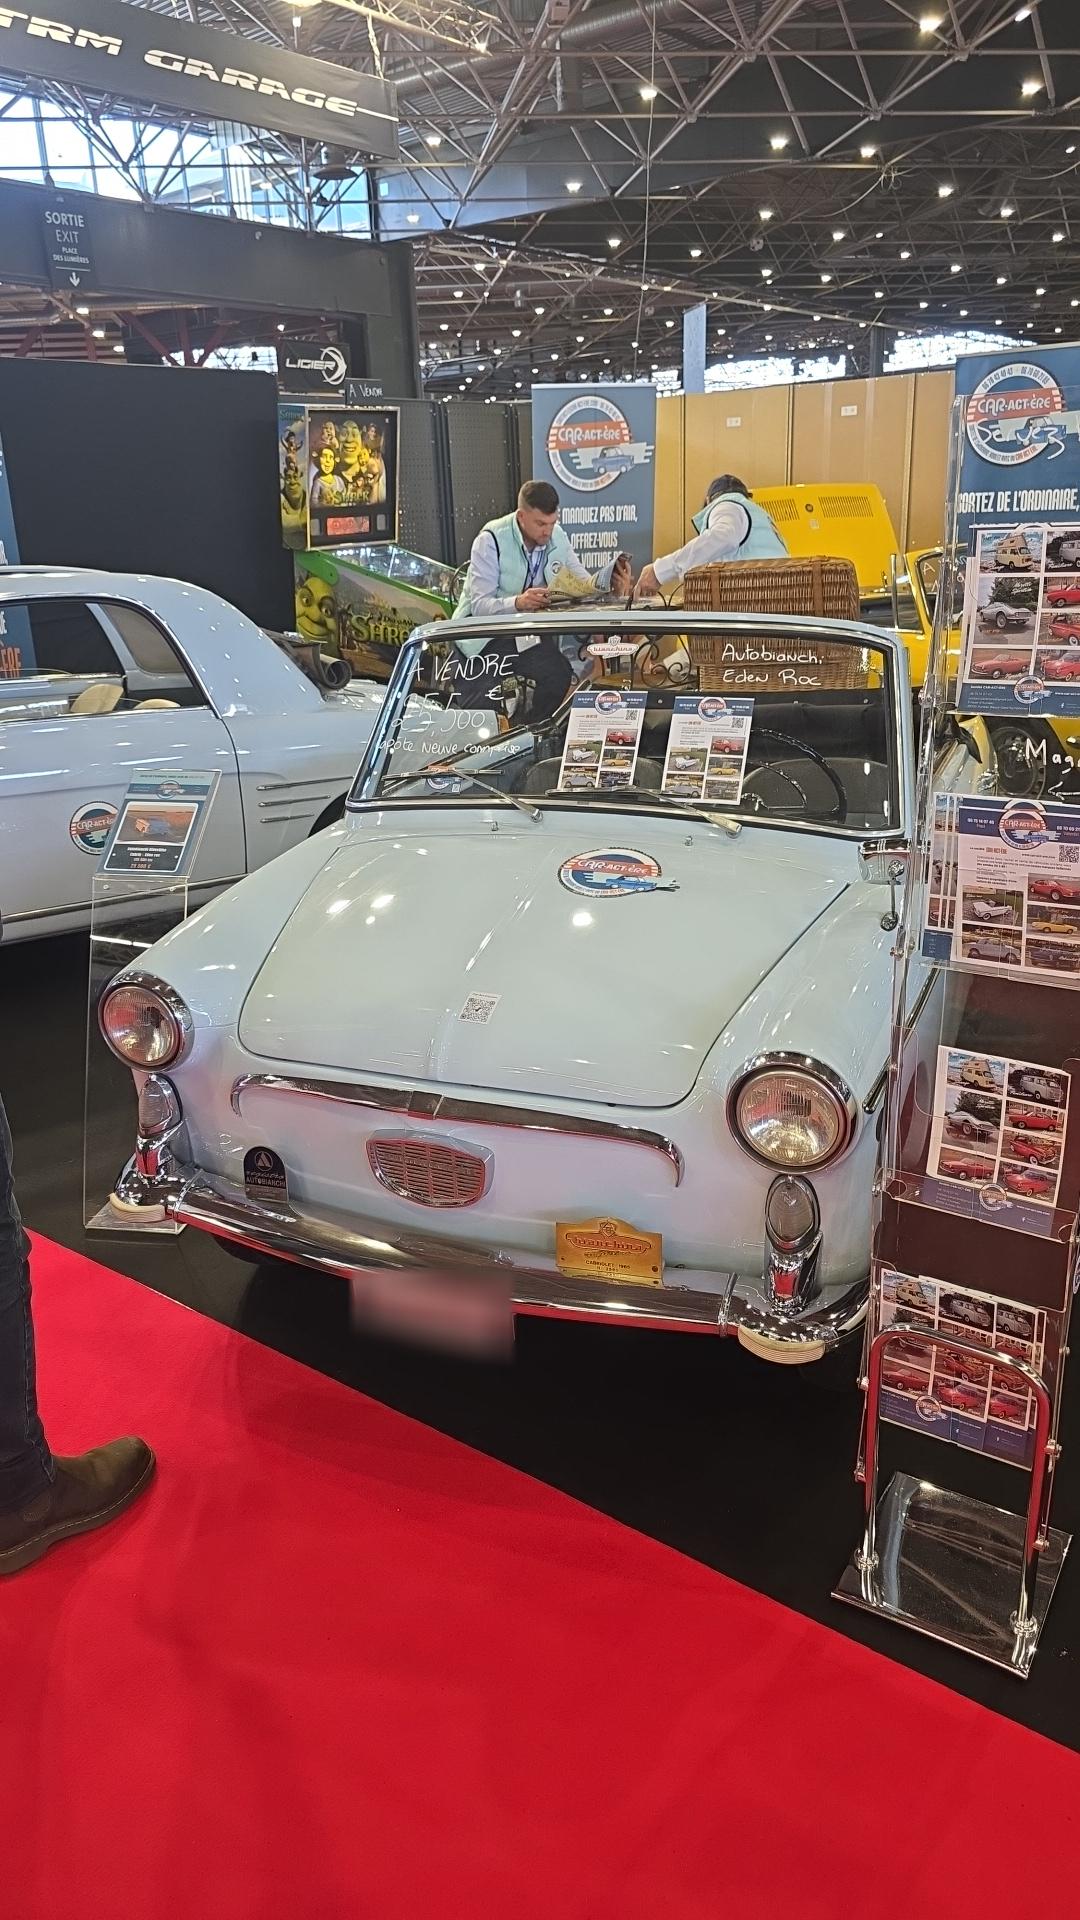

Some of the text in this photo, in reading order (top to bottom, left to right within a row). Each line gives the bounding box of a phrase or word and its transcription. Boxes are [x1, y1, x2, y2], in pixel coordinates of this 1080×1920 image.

[143, 49, 358, 117] GARAGE
[45, 211, 85, 227] SORTIE
[56, 230, 79, 243] EXIT
[62, 246, 78, 254] PLACE
[285, 358, 335, 370] LIGIER
[349, 384, 356, 397] A
[997, 491, 1011, 512] DE
[1013, 488, 1080, 512] L'ORDINAIRE,
[562, 507, 598, 525] MANQUEZ
[600, 506, 615, 522] PAS
[616, 505, 638, 522] D'AIR,
[571, 531, 618, 549] OFFREZ-VOUS
[408, 651, 519, 681] A VENDRE
[723, 669, 821, 685] Eden Roc
[485, 685, 504, 700] €
[246, 1176, 286, 1187] AUTOBIANCHI
